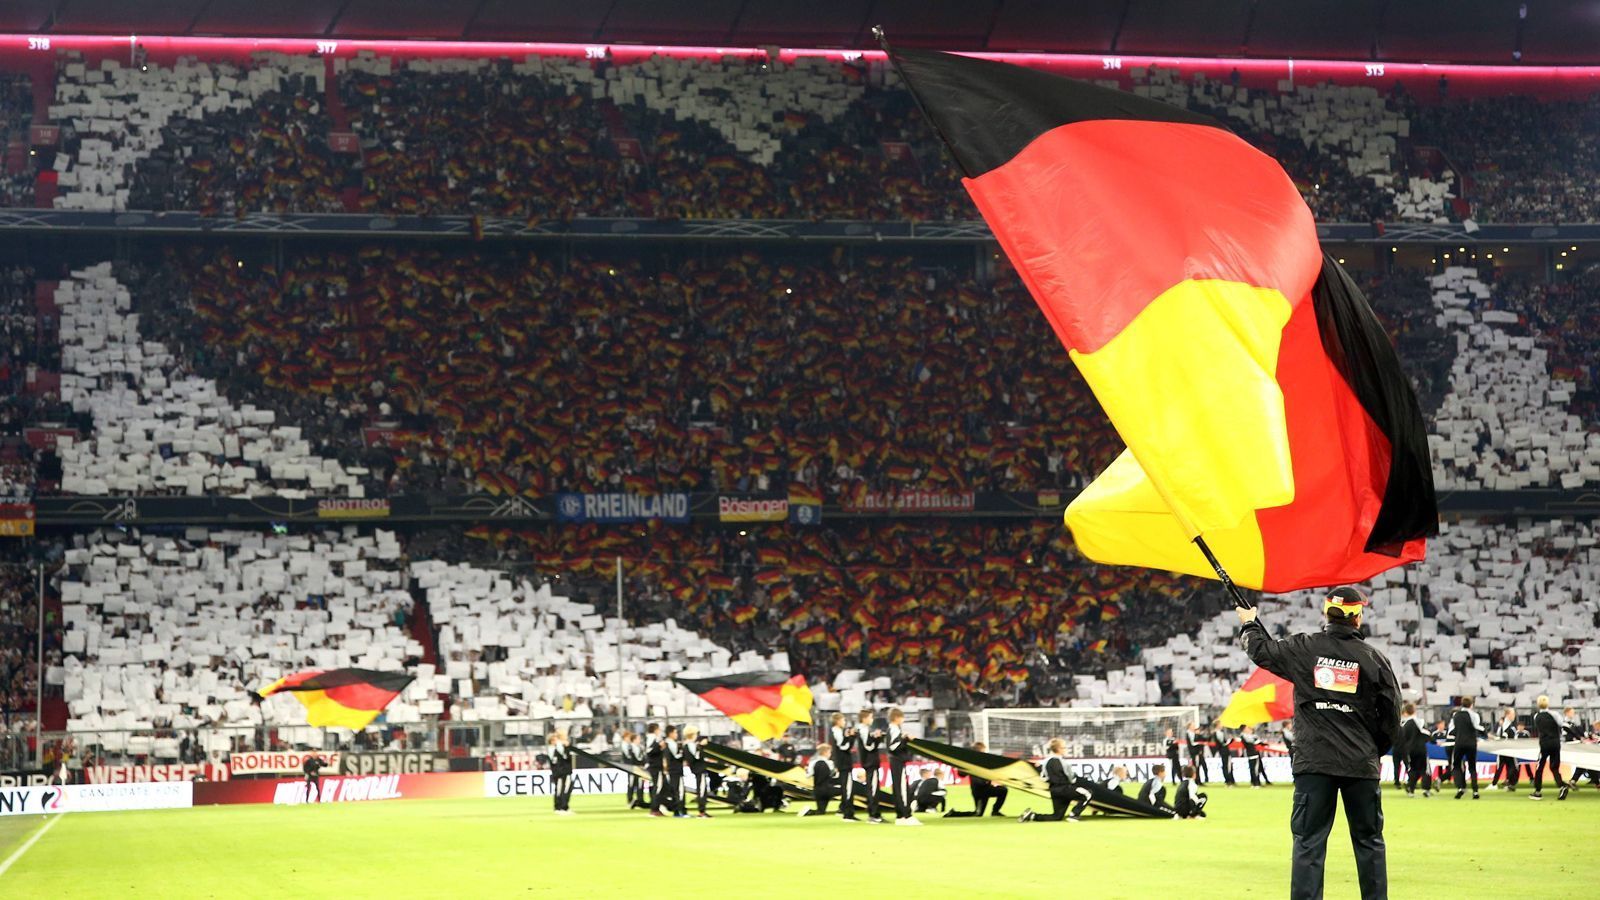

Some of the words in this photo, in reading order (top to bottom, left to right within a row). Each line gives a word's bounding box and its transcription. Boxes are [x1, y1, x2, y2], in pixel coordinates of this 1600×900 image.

[584, 493, 688, 518] RHEINLAND
[719, 496, 789, 519] Bösingen
[1317, 656, 1336, 667] FAN
[1335, 659, 1359, 670] CLUB
[345, 754, 433, 776] SPENGE
[497, 773, 619, 796] GERANY
